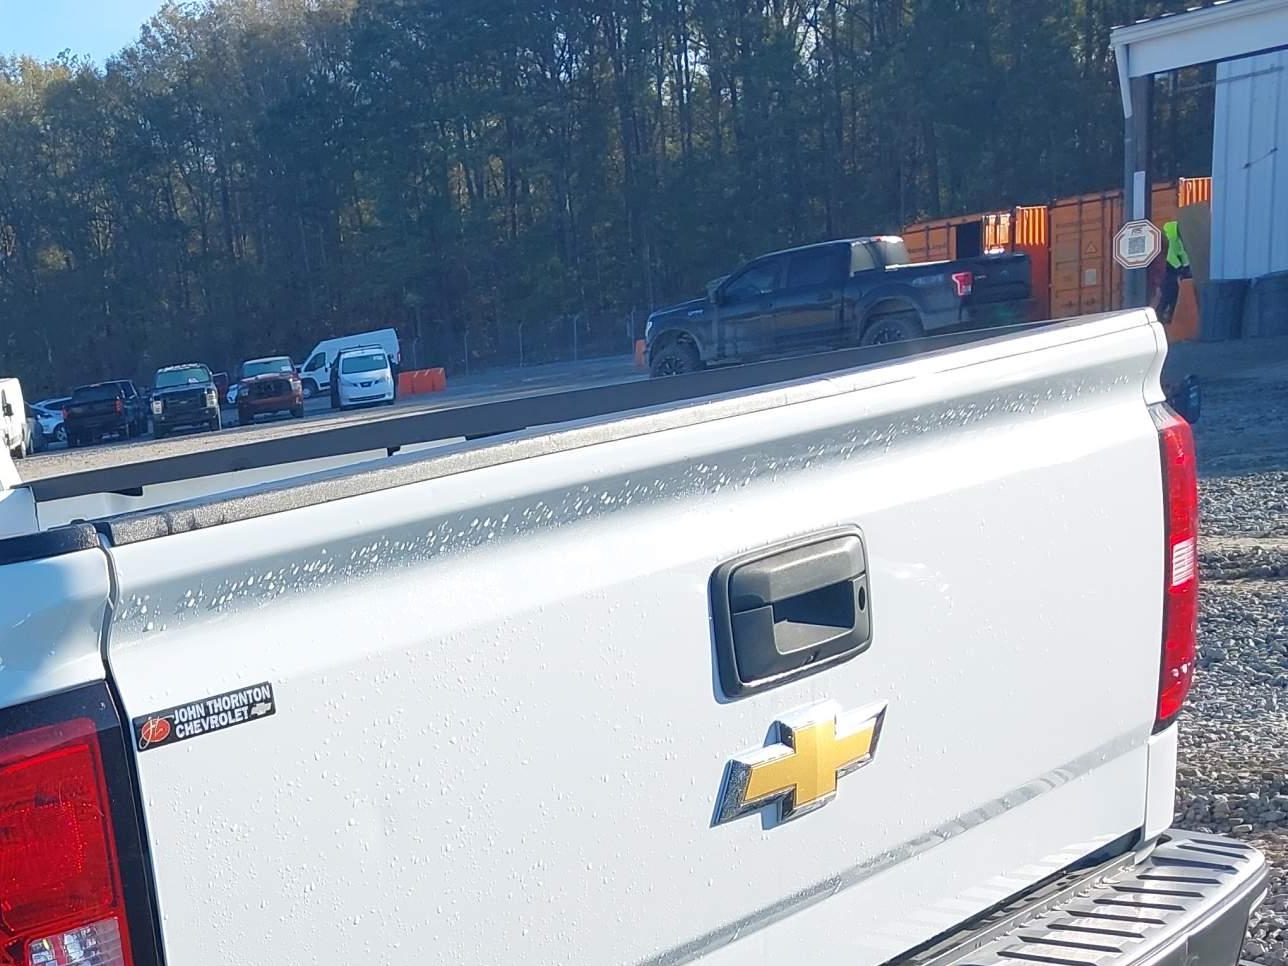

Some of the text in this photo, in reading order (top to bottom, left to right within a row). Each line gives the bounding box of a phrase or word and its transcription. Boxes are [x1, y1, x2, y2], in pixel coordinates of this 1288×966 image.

[173, 684, 271, 725] JOHN THORNTON
[175, 705, 249, 738] CHEVROLET
